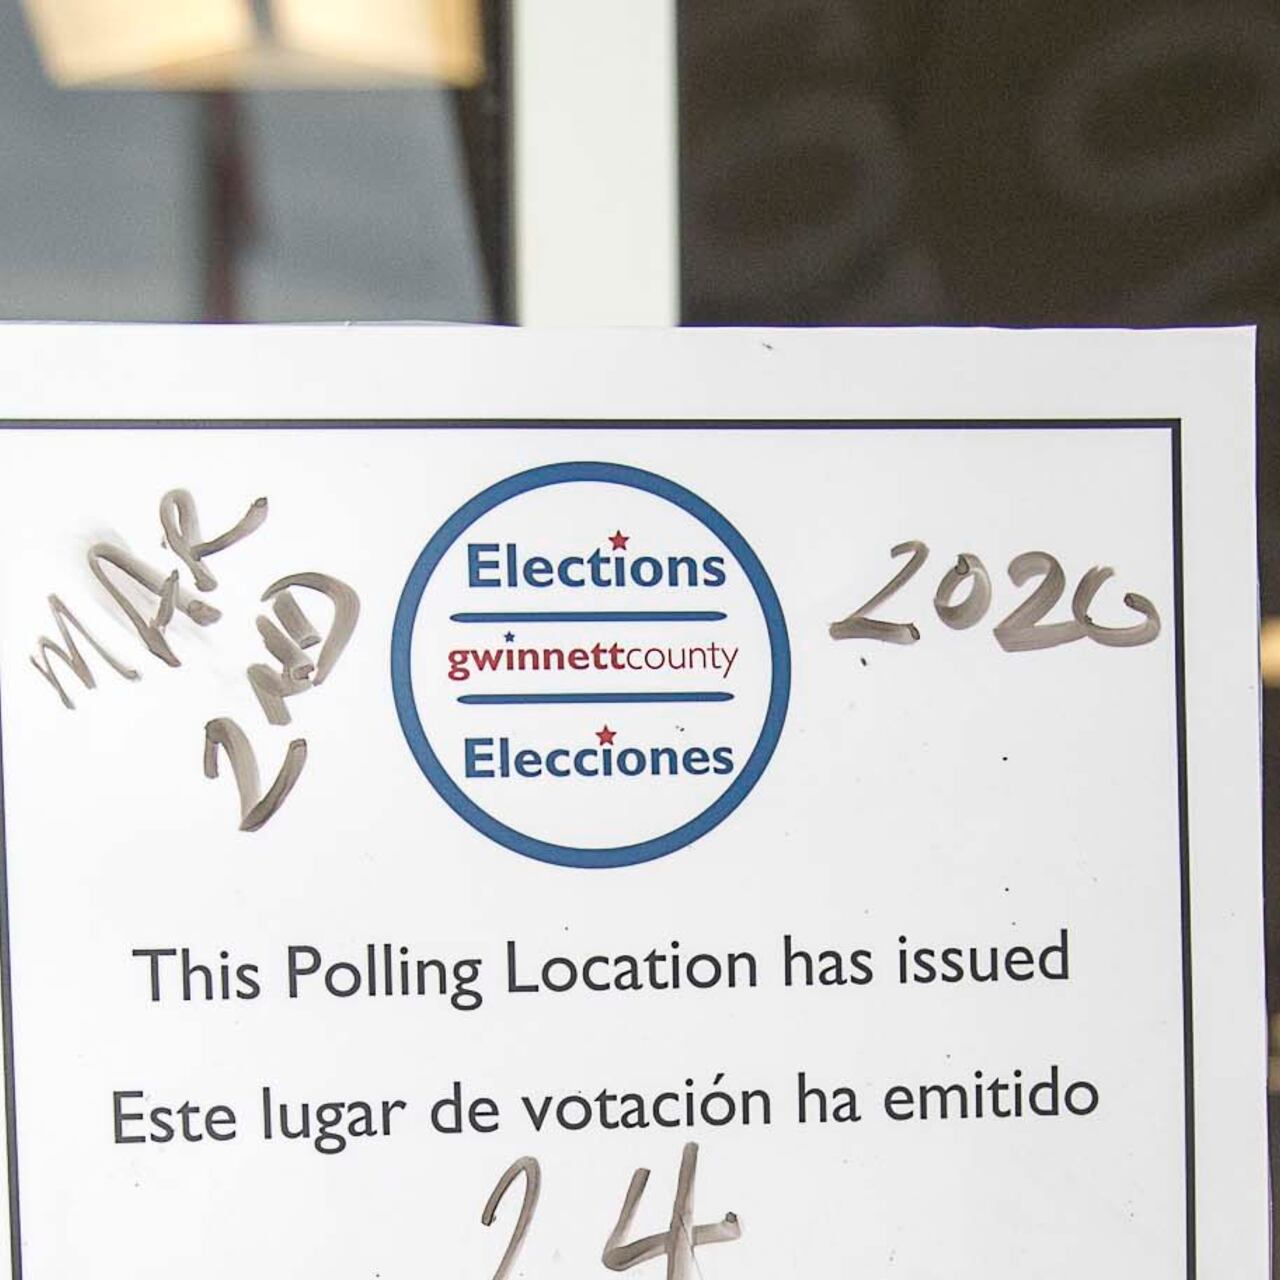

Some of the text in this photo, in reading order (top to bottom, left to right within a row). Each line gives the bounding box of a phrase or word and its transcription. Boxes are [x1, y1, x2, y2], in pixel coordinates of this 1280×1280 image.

[466, 530, 728, 589] Elections
[447, 630, 740, 682] gwinnettcounty
[463, 725, 736, 779] Elecciones
[131, 928, 1070, 1012] This Polling Location has issued
[112, 1064, 1100, 1155] Este lugar de votación ha emitido
